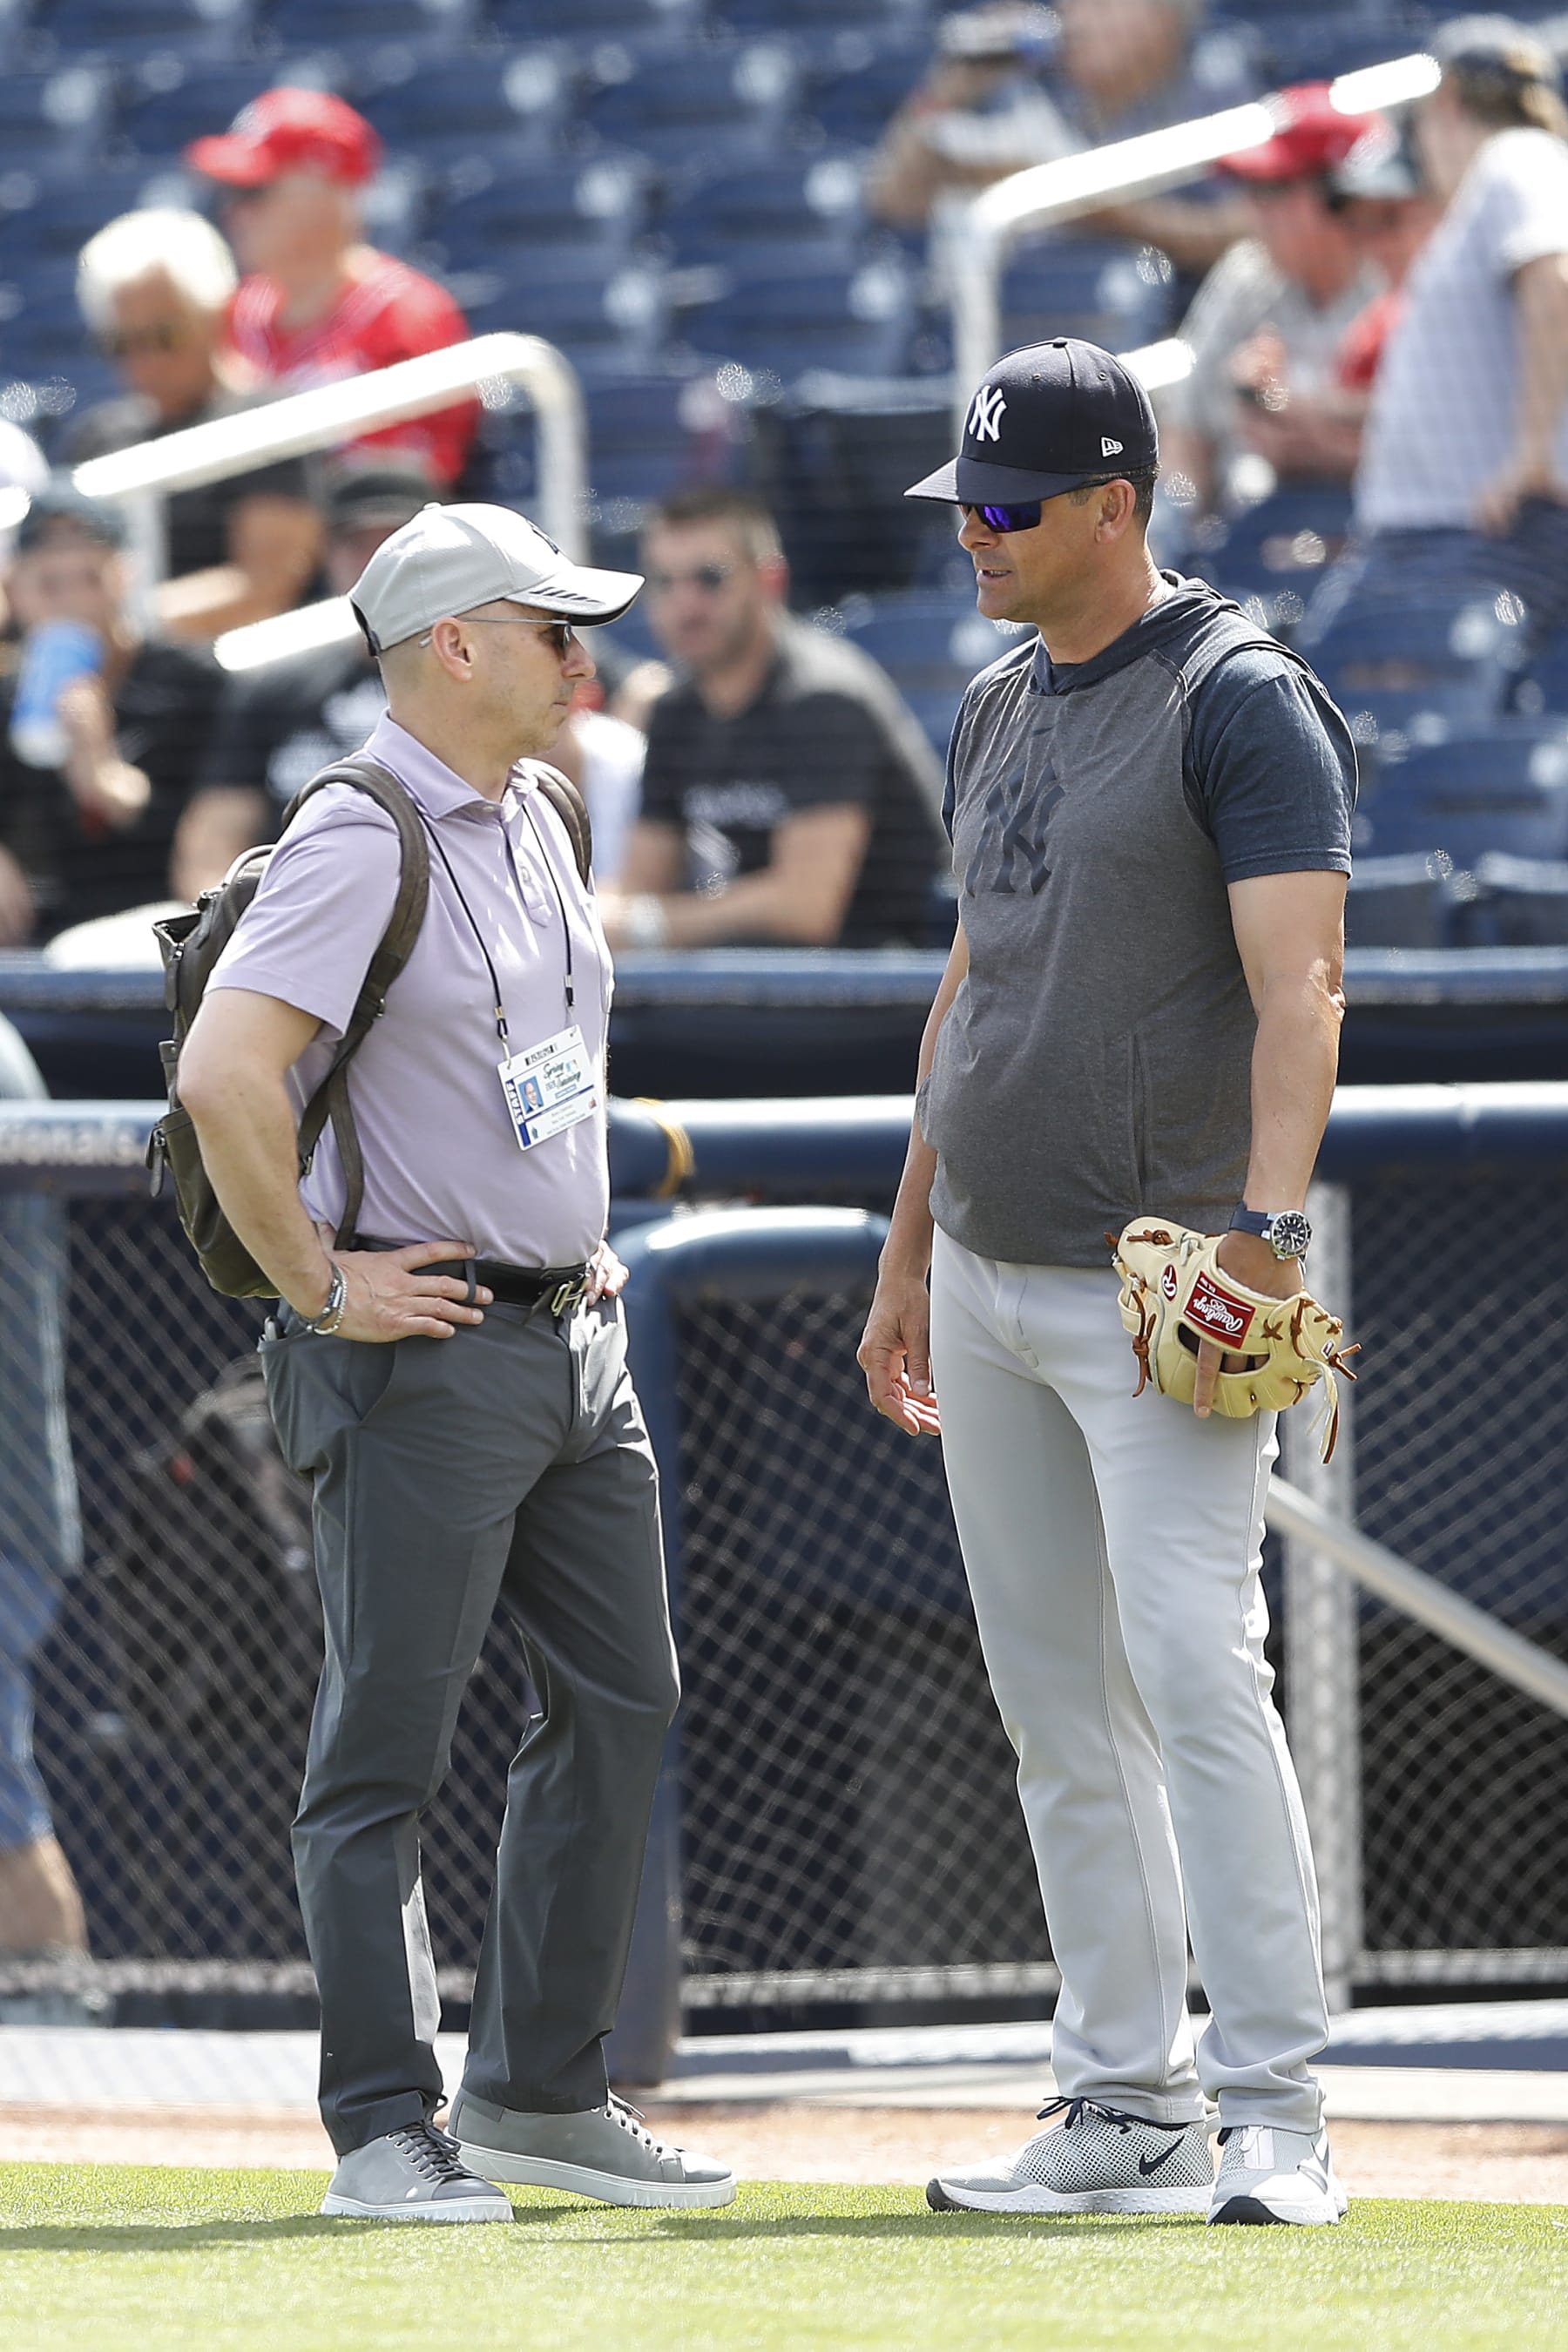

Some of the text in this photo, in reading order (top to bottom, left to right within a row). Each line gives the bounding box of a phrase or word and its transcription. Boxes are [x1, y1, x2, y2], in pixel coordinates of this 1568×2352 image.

[969, 385, 1007, 442] NY
[965, 756, 1066, 897] NY
[505, 1080, 525, 1125] STAFF
[1192, 1295, 1244, 1332] Rawlings
